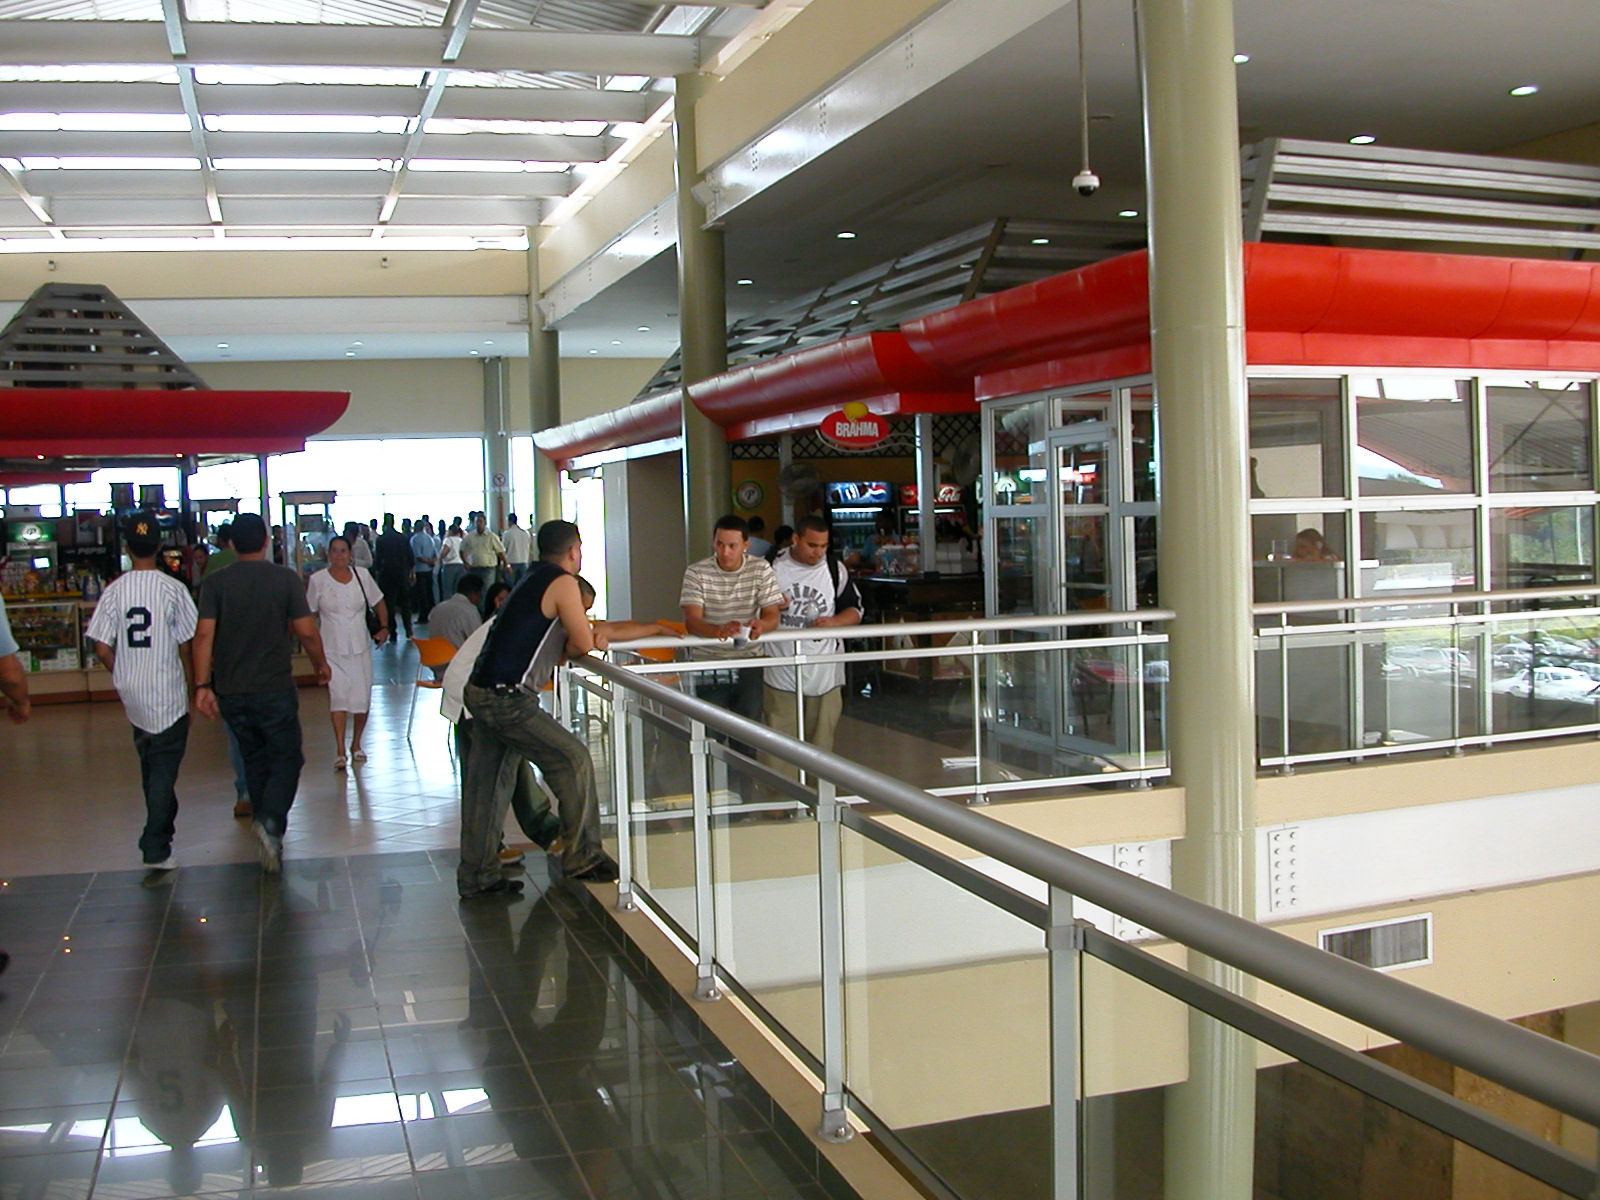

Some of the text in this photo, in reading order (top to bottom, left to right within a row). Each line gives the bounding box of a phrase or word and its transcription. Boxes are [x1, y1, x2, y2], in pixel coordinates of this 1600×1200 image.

[836, 421, 879, 437] BRAHMA
[937, 486, 961, 502] Cola
[126, 606, 152, 648] 2
